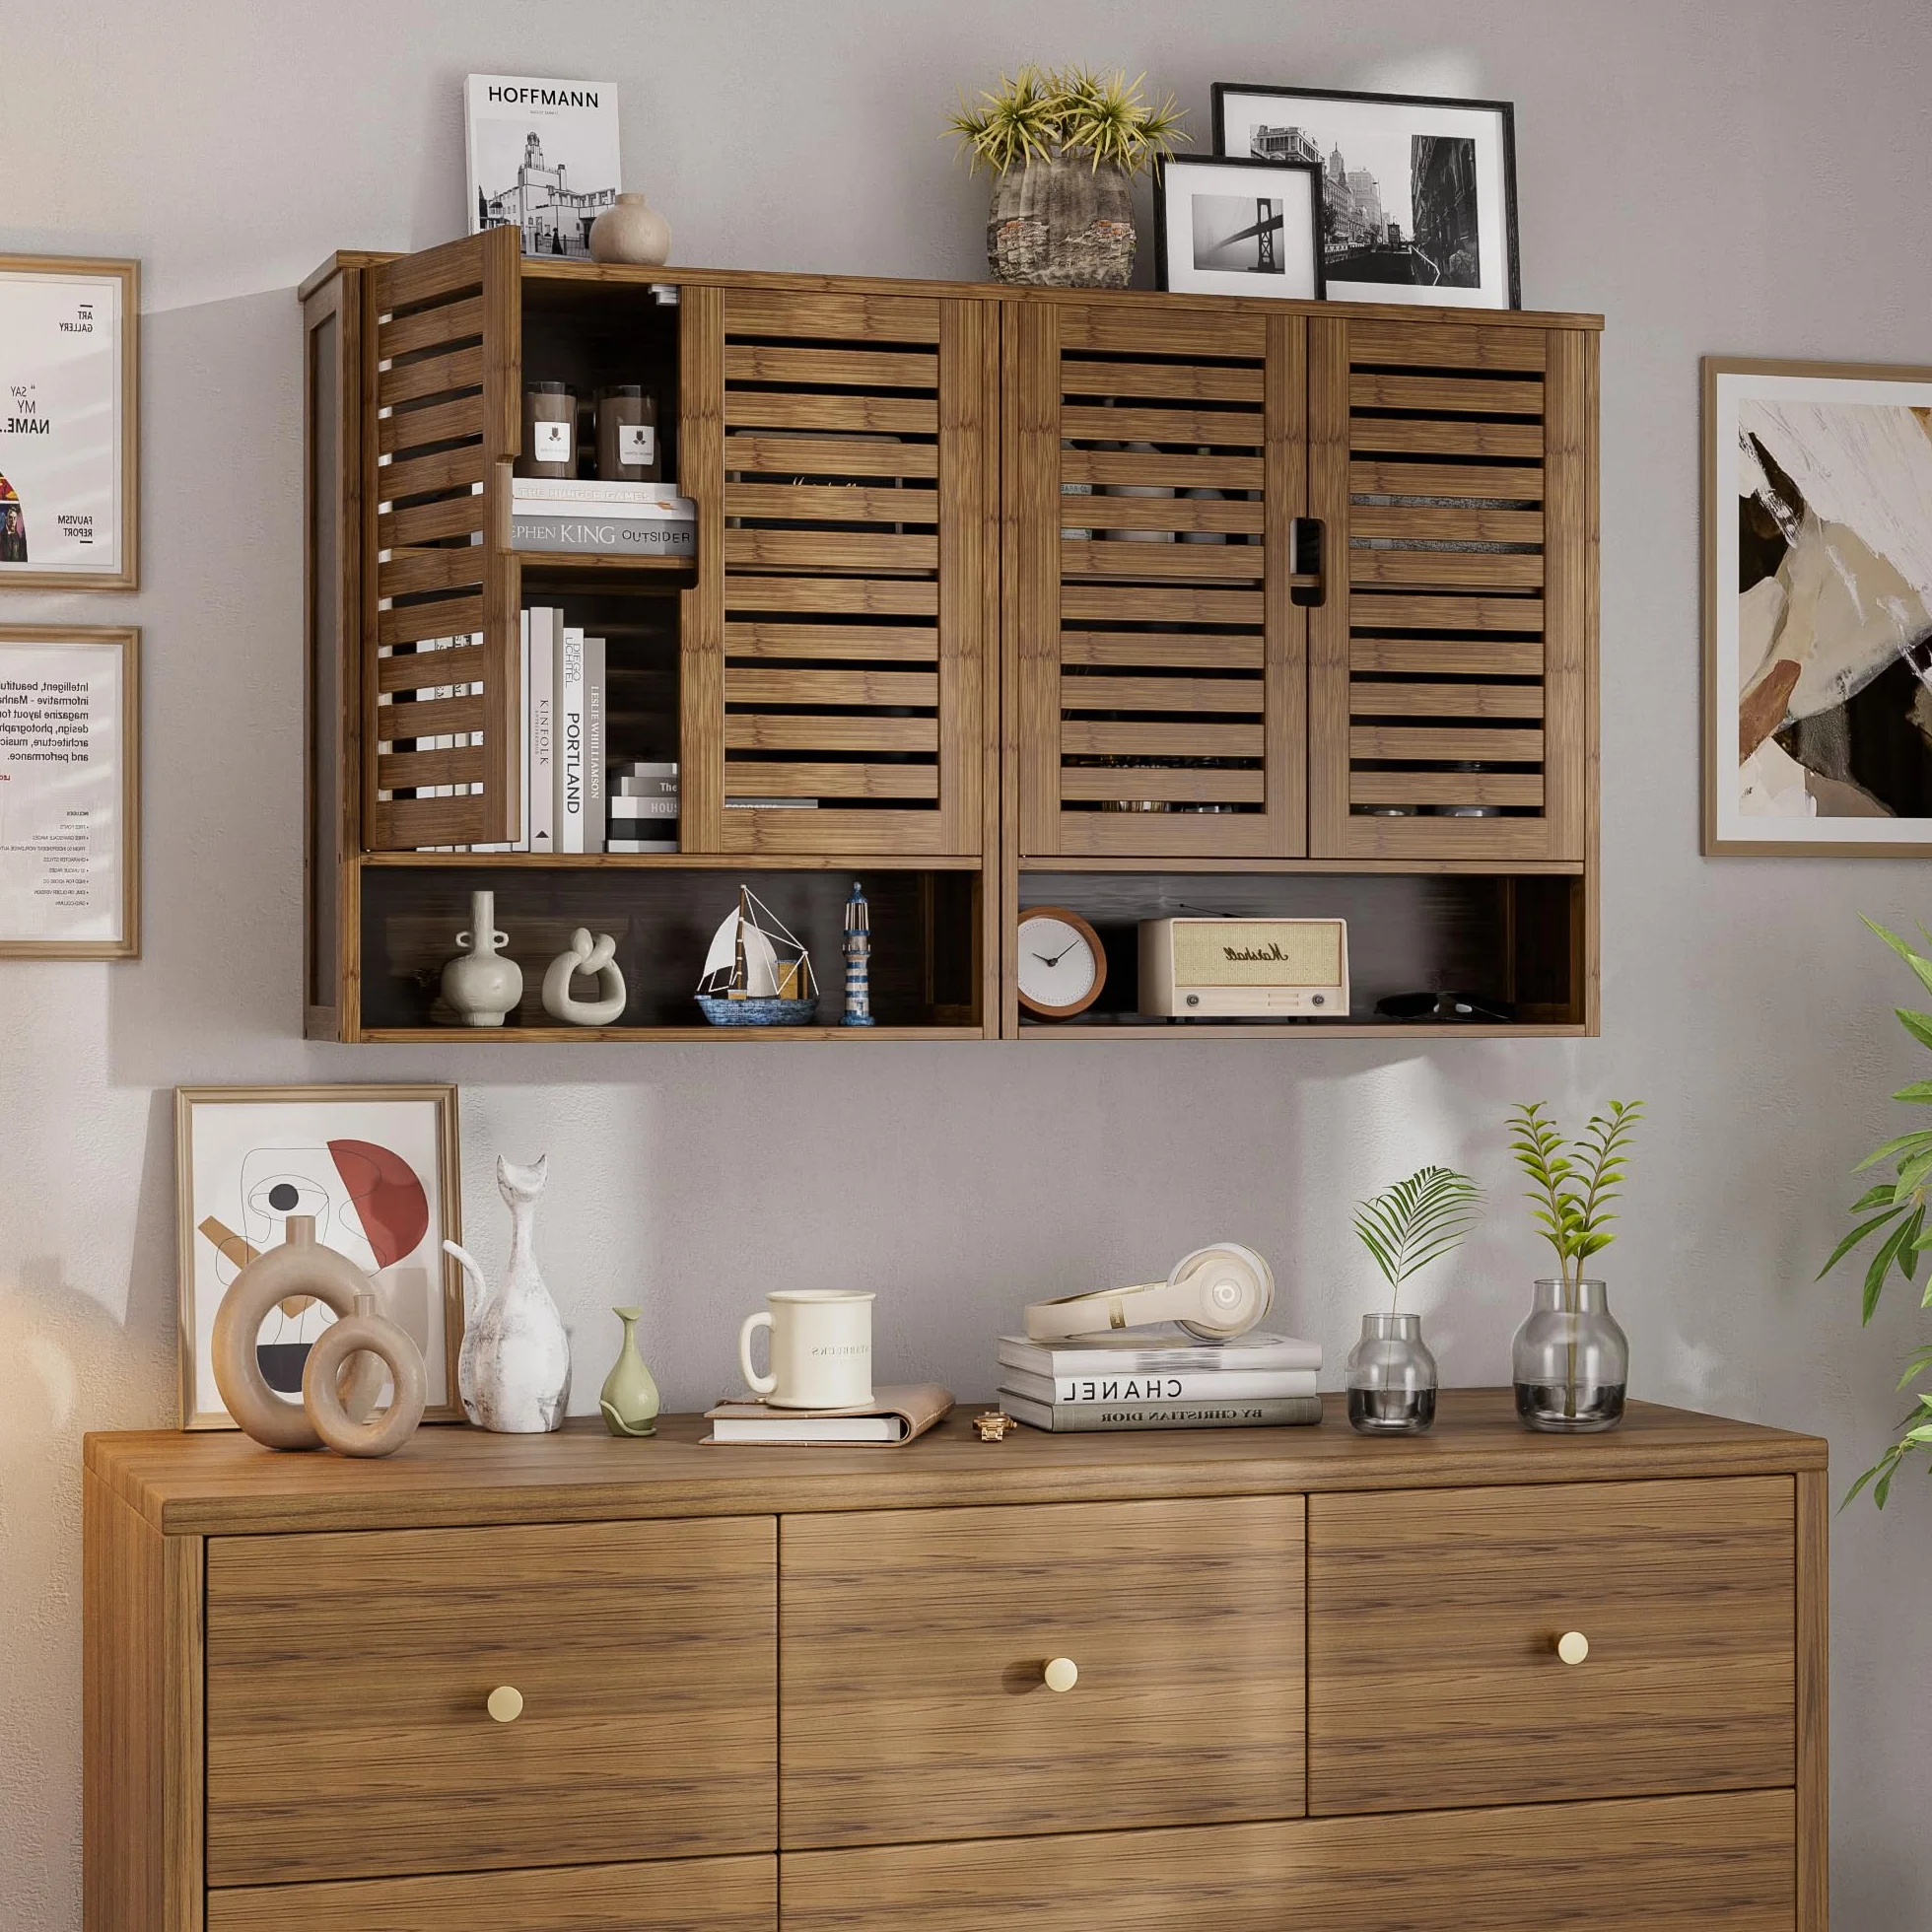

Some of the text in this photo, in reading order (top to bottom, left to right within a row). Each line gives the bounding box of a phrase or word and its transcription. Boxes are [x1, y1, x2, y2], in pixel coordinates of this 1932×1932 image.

[489, 87, 598, 107] HOFFMANN
[561, 524, 615, 544] KING
[622, 529, 690, 543] OUTSIDER
[573, 644, 582, 682] DIEGO
[590, 686, 599, 721] LESLIE
[567, 713, 580, 814] PORTLAND
[660, 782, 677, 793] The
